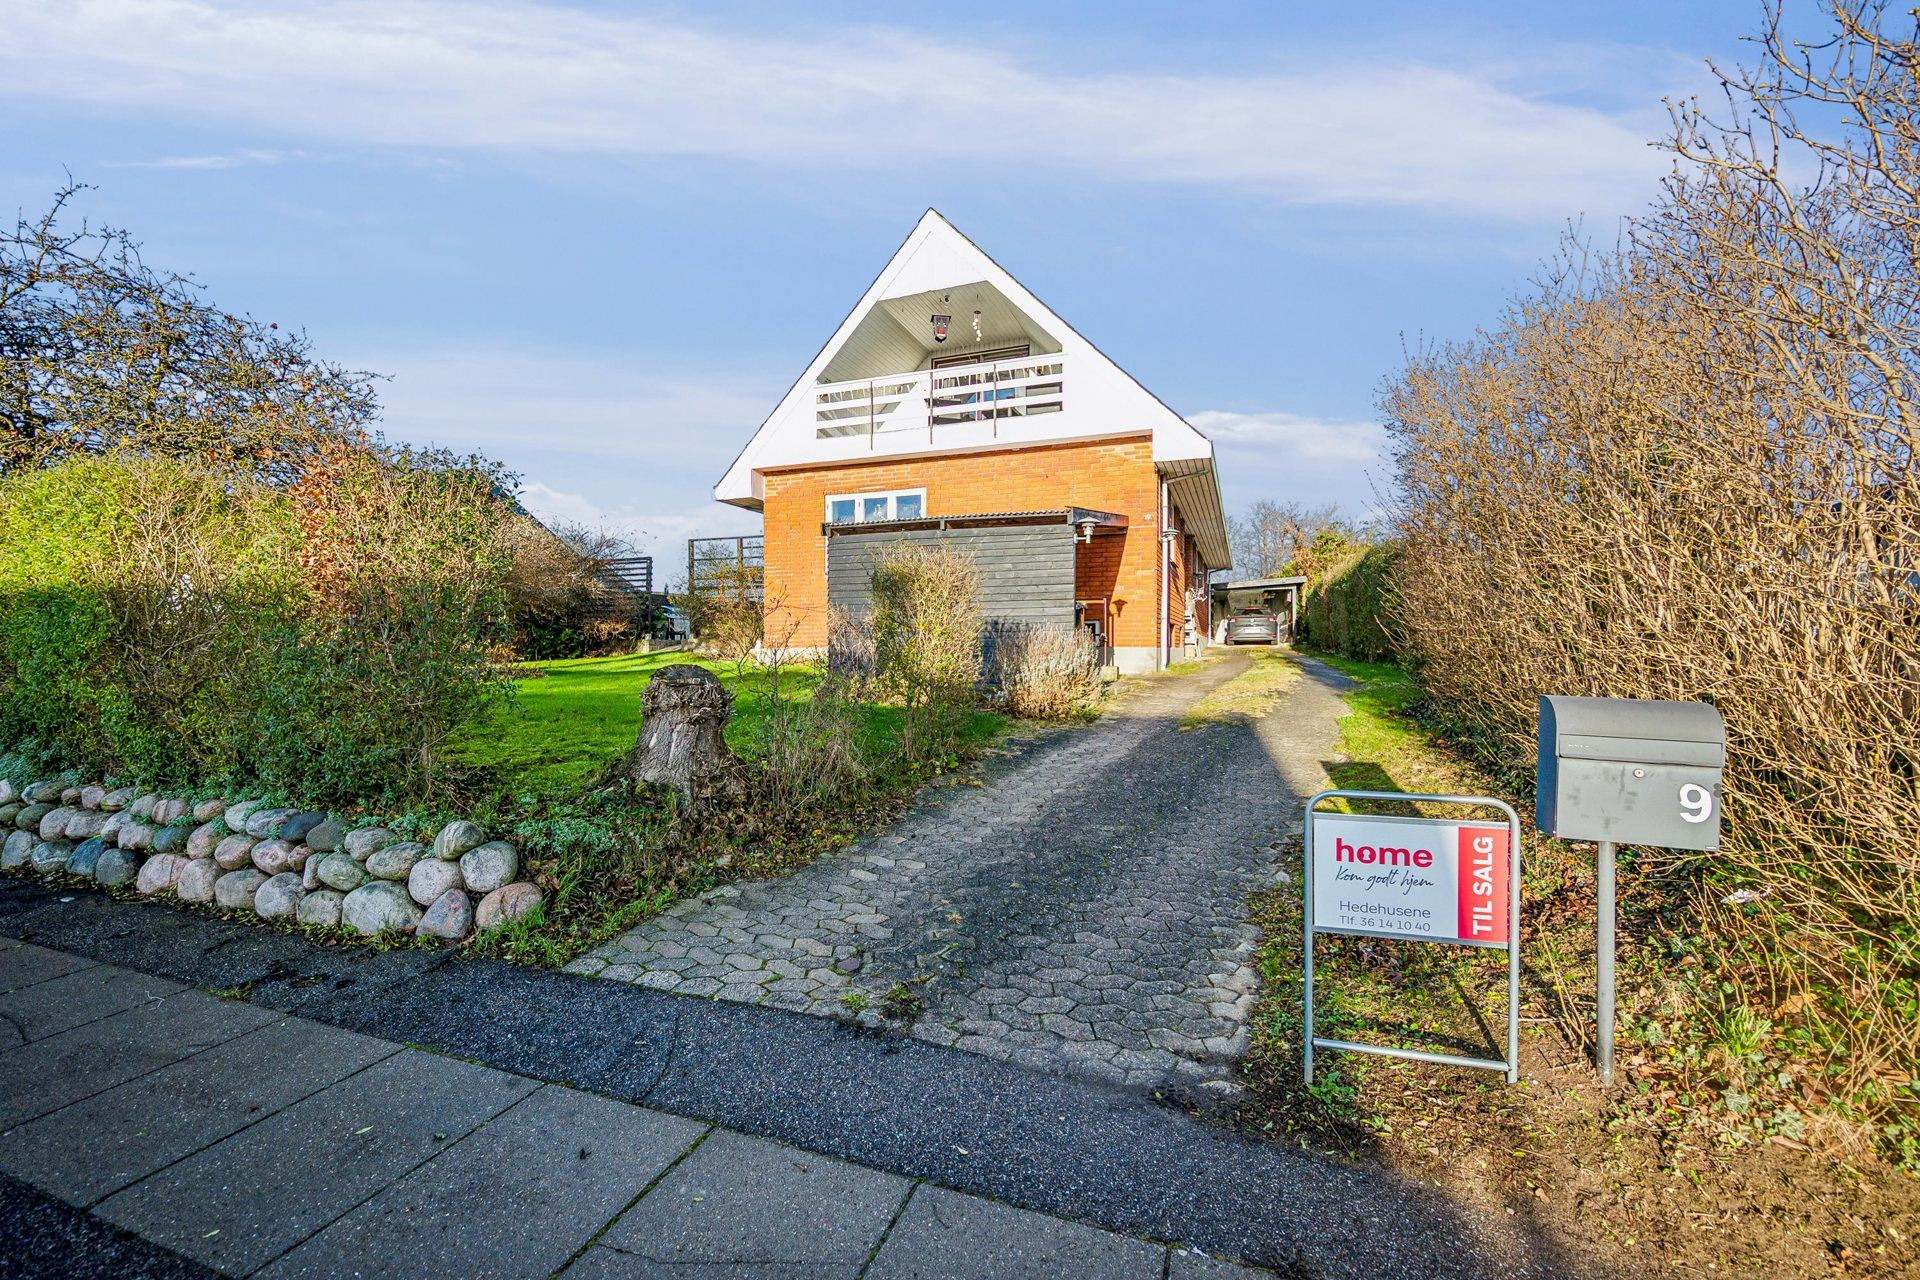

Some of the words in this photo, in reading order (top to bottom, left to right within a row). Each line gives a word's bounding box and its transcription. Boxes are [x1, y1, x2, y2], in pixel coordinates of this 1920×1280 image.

[1679, 783, 1712, 823] 9
[1336, 838, 1433, 868] home
[1472, 836, 1494, 897] SALG
[1335, 865, 1364, 881] Kom
[1364, 868, 1400, 891] godt
[1400, 870, 1434, 896] hjem
[1339, 900, 1431, 919] Hedehusene
[1339, 915, 1357, 926] Tlf.
[1360, 917, 1375, 927] 36
[1379, 918, 1393, 928] 14
[1397, 920, 1412, 931] 10
[1414, 922, 1431, 932] 40
[1472, 900, 1493, 936] TIL
